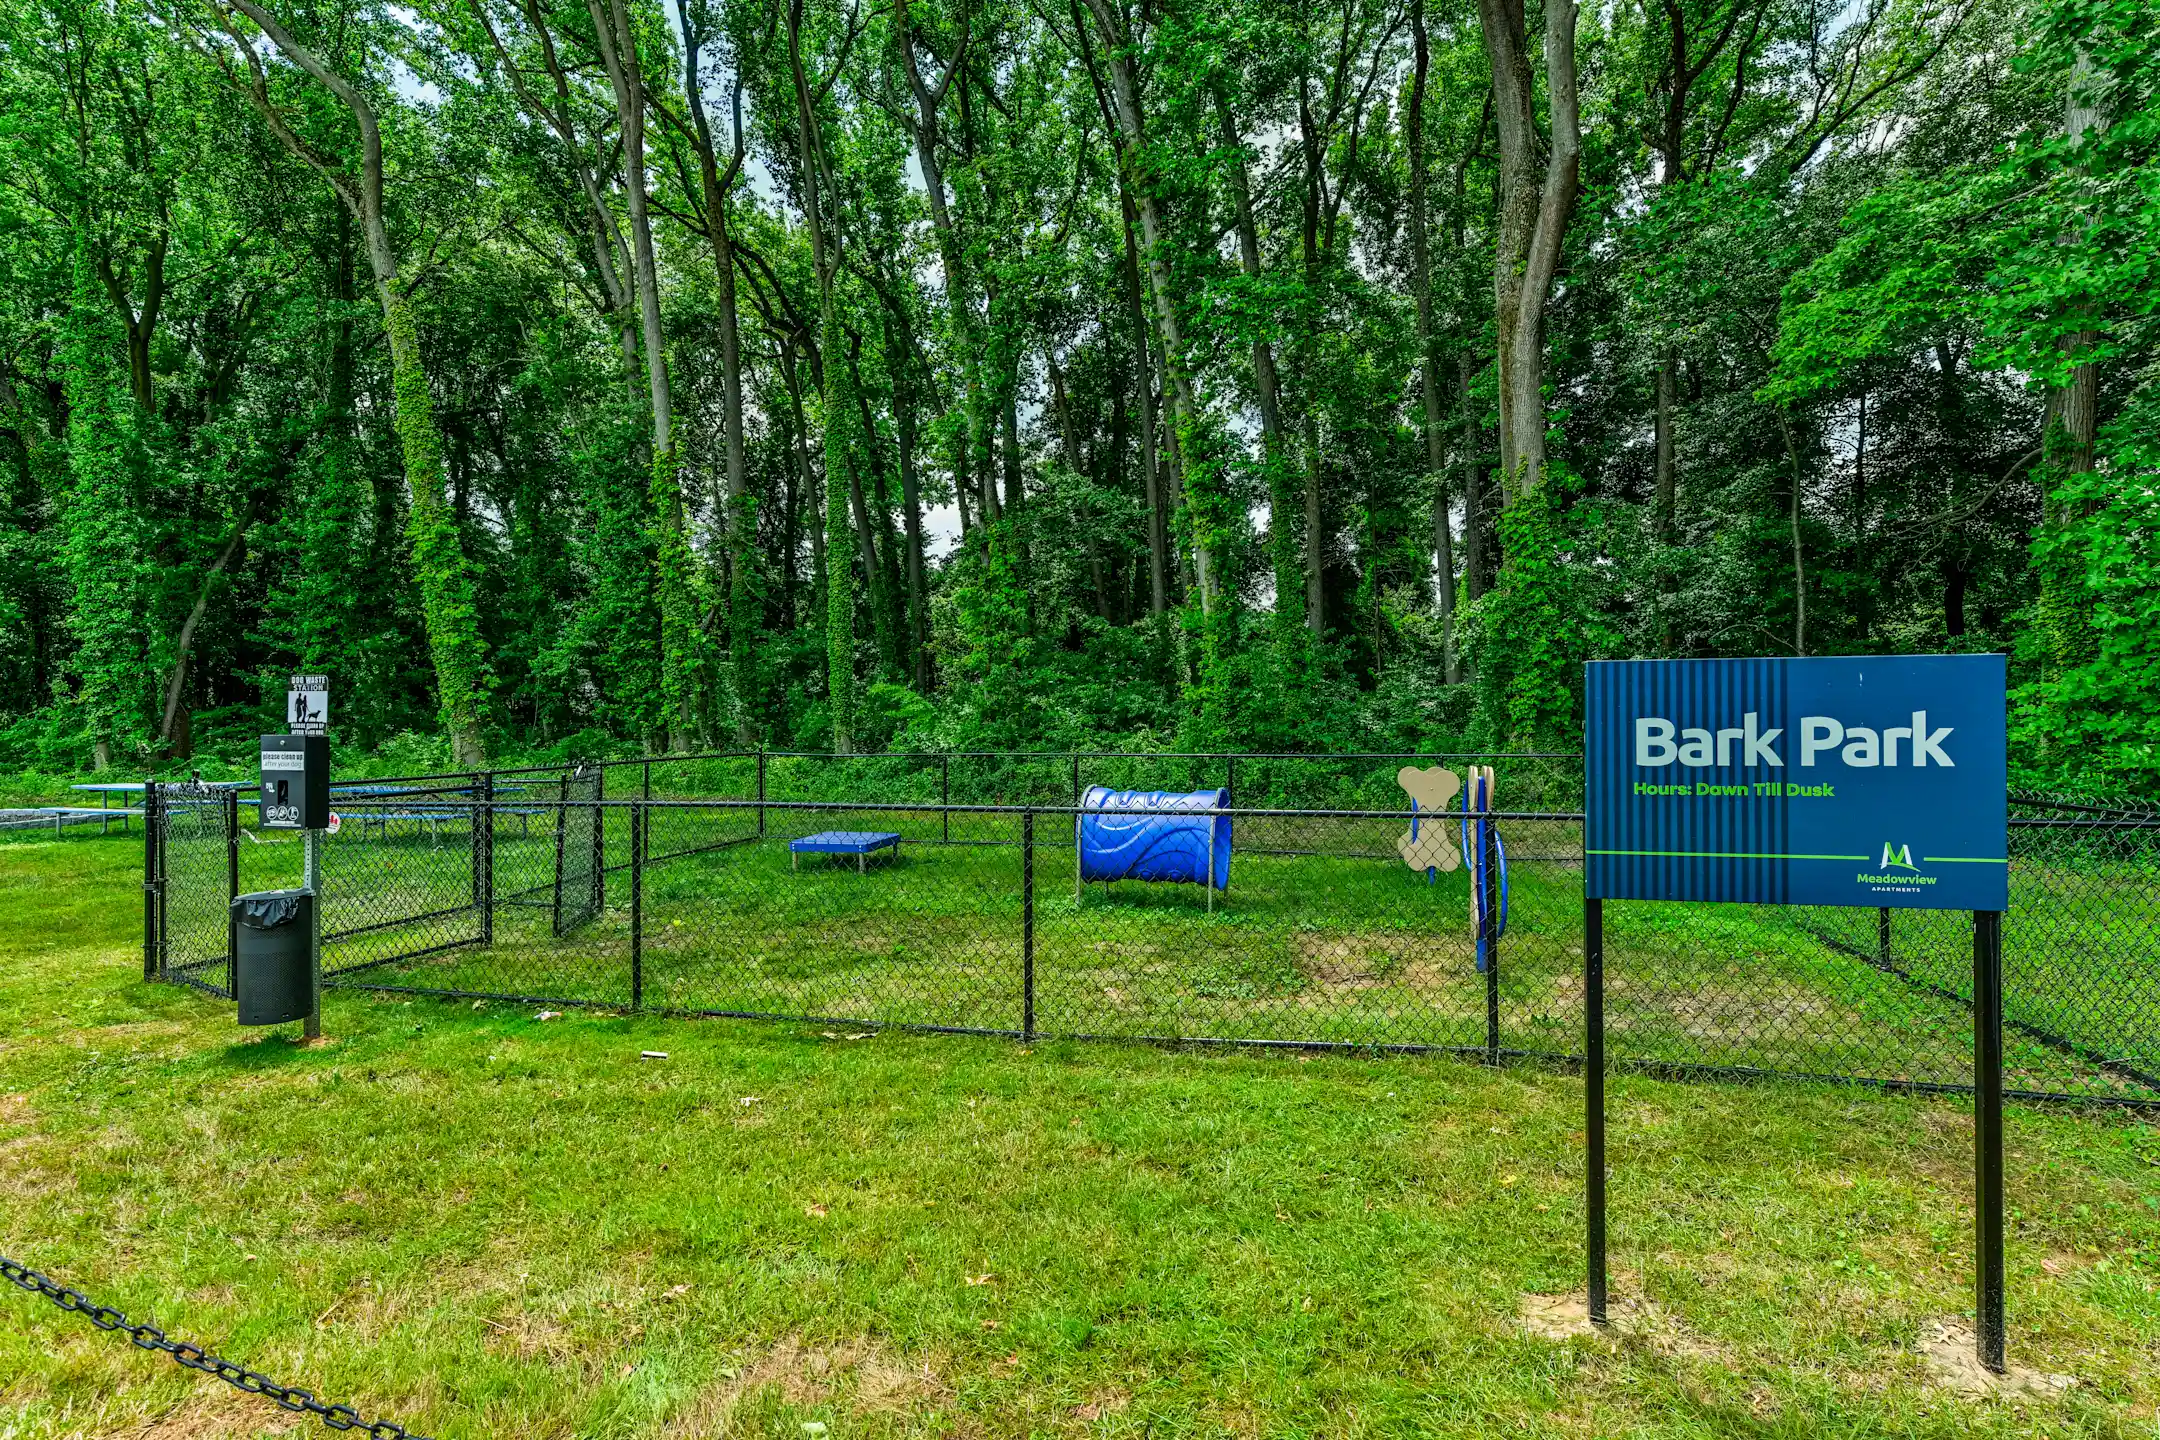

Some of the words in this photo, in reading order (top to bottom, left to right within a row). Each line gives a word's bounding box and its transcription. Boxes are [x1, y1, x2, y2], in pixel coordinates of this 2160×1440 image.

[1635, 711, 1784, 767] Bark
[1800, 710, 1956, 767] Park
[291, 760, 302, 768] dog
[1633, 781, 1692, 796] Hours:
[1696, 782, 1749, 796] Dawn
[1753, 781, 1782, 797] Till
[1786, 782, 1835, 797] Dusk
[1856, 873, 1937, 885] Meadowview
